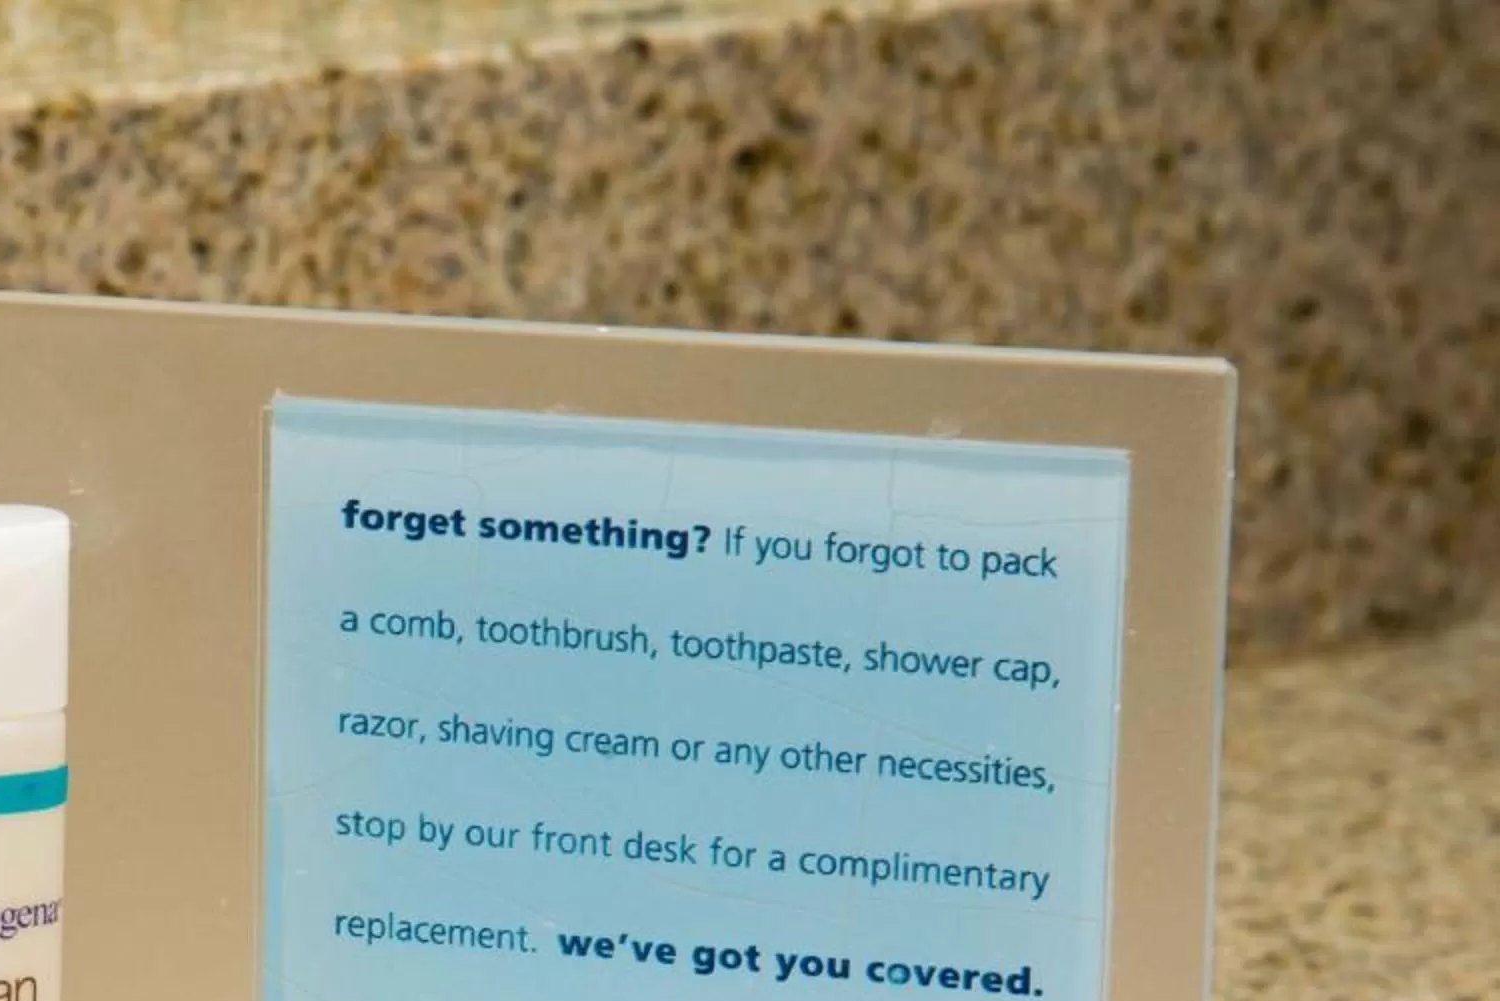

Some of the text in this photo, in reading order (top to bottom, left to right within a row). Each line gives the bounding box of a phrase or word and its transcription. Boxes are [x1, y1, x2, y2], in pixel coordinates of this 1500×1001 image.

[341, 499, 1059, 581] forget something? If you forgot to pack
[341, 610, 1060, 690] a comb, toothbrush, toothpaste, shower cap,
[338, 708, 1056, 793] razor, shaving cream or any other necessities,
[336, 808, 1050, 900] stop by our front desk for a complimentary
[334, 909, 538, 955] replacement.
[691, 942, 762, 975] got
[775, 946, 853, 982] you
[865, 957, 1044, 998] covered.
